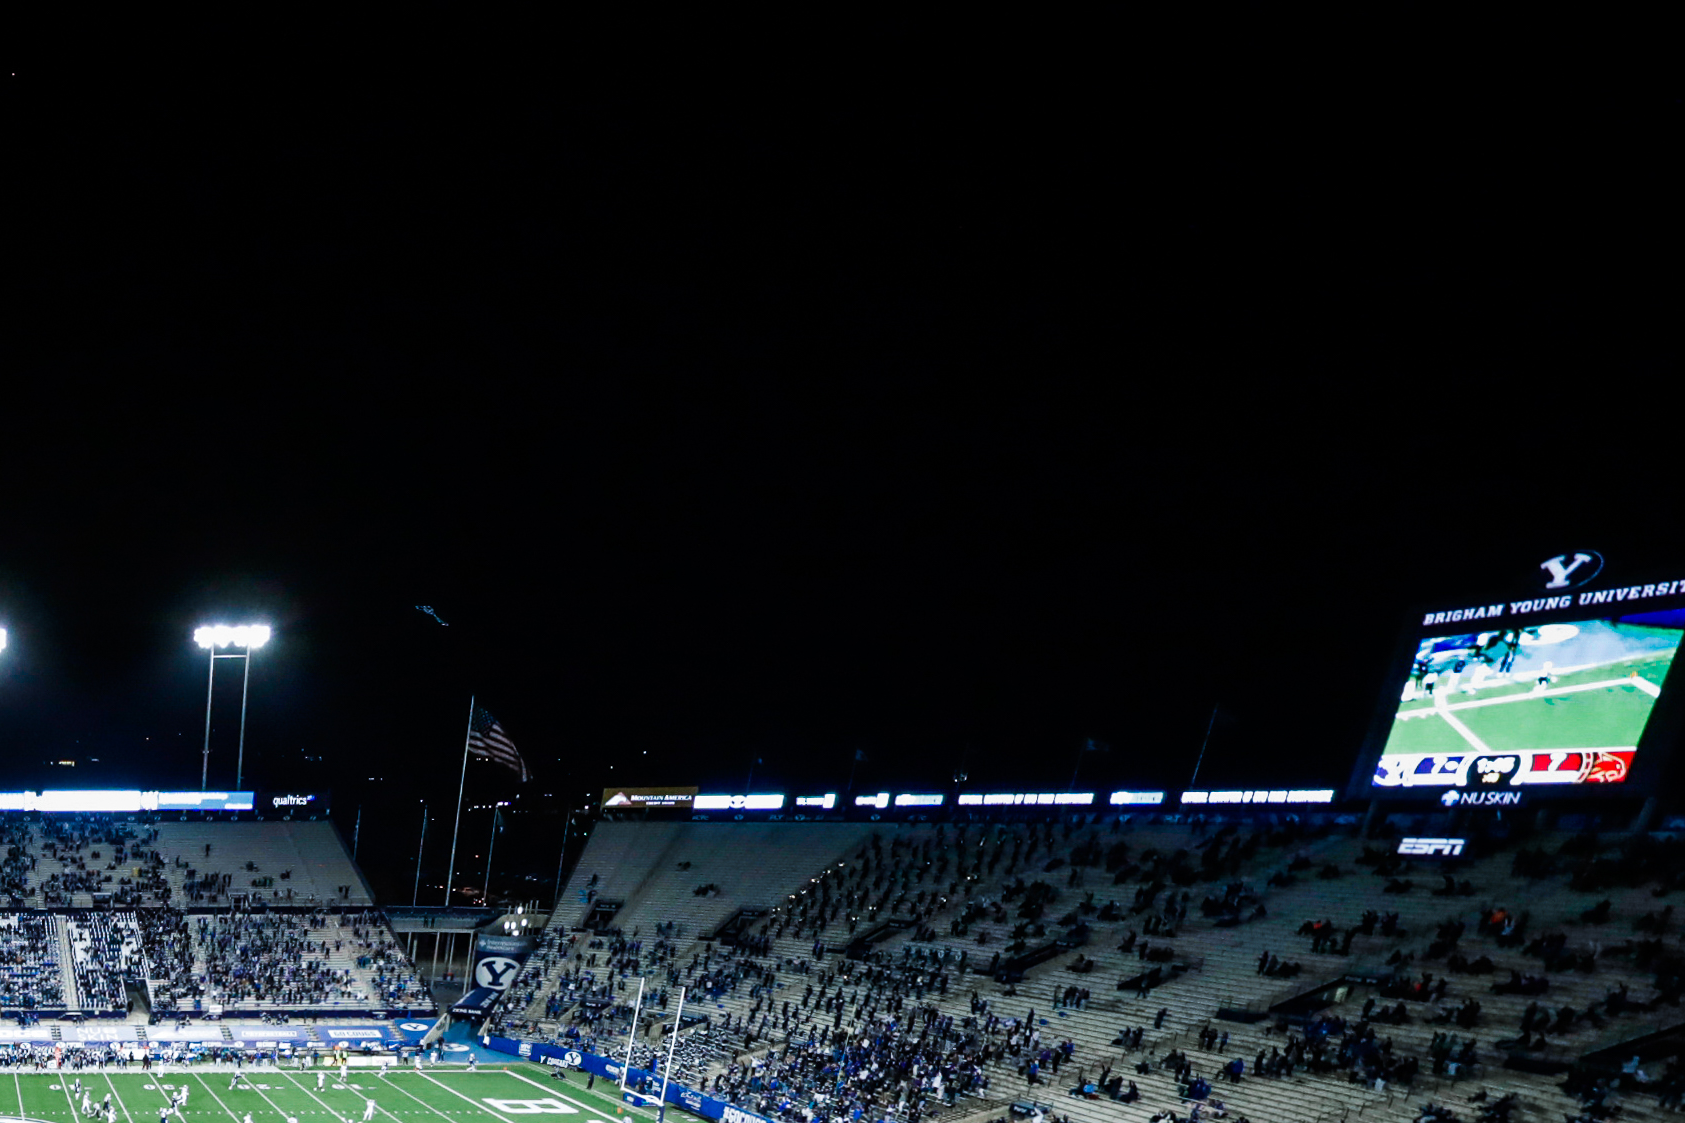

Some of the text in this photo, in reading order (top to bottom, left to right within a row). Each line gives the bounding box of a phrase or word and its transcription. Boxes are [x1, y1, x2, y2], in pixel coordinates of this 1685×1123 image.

[1422, 604, 1504, 626] BRIGHAM
[1510, 595, 1572, 615] YOUNG
[273, 794, 307, 807] qualtrics
[1461, 792, 1522, 805] NU SKIN
[1397, 838, 1466, 856] ESPN
